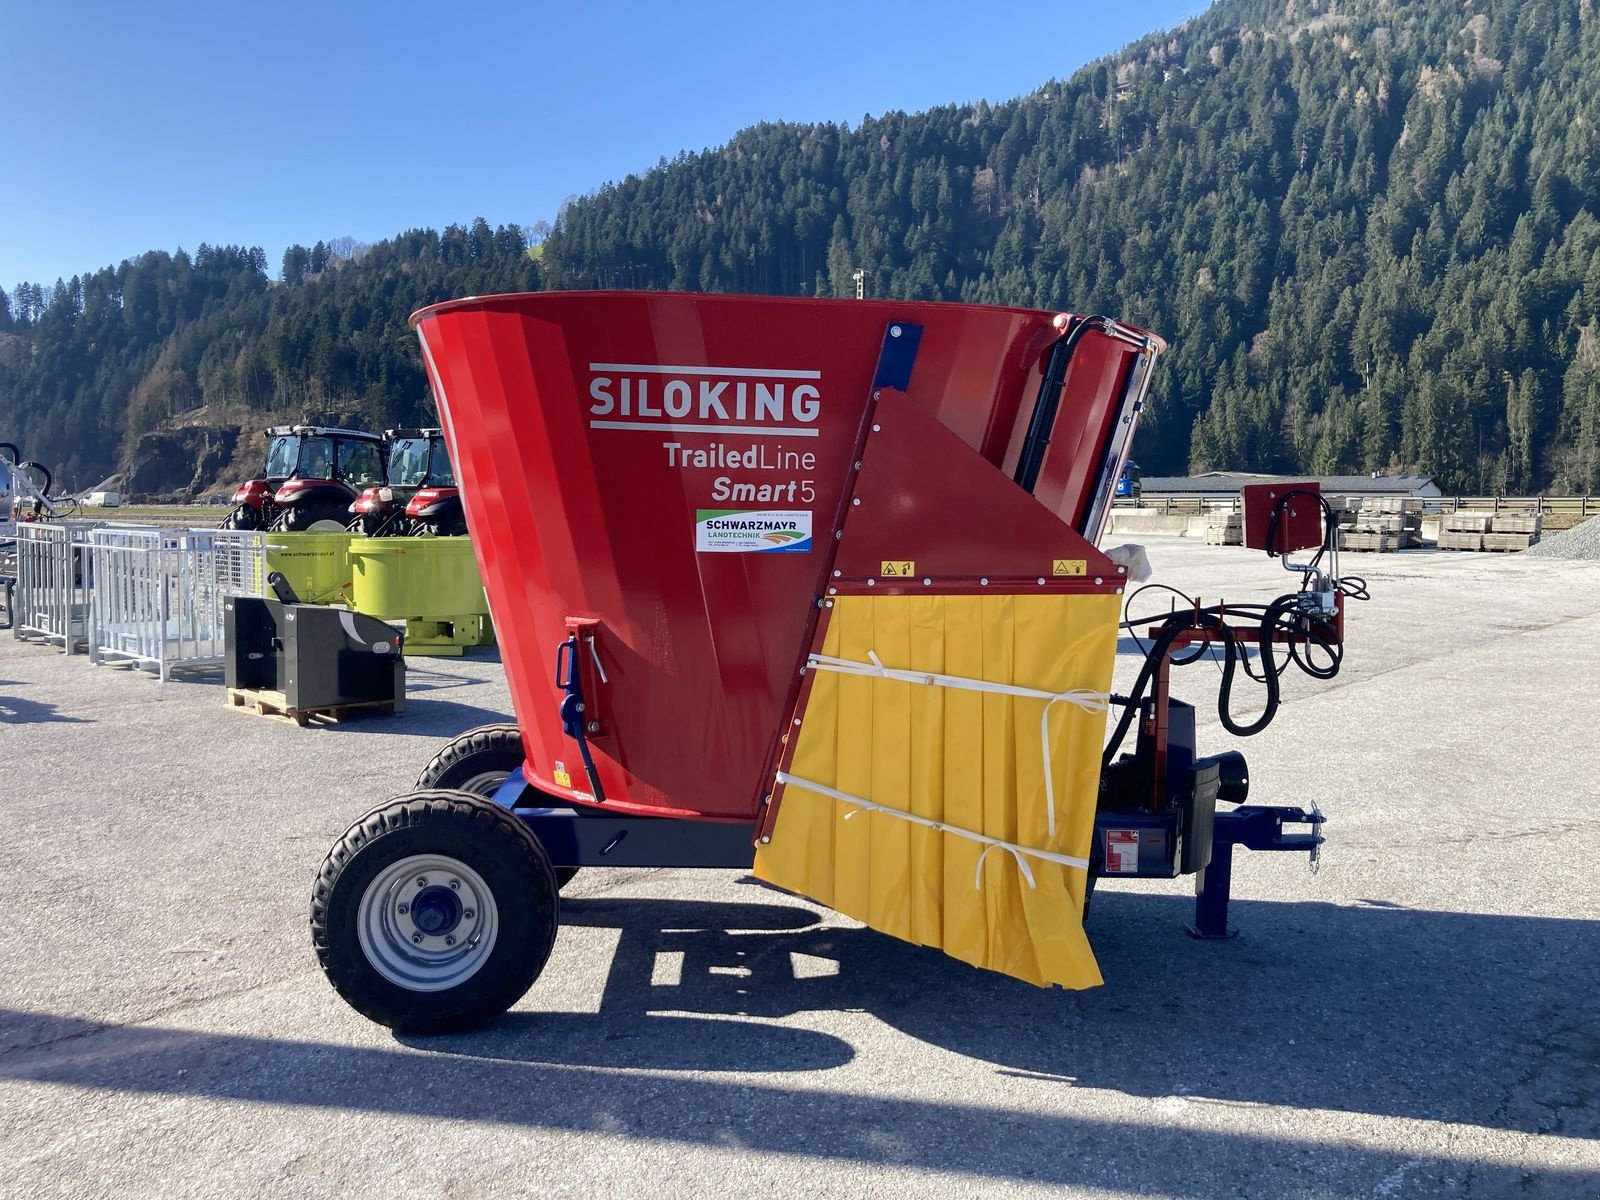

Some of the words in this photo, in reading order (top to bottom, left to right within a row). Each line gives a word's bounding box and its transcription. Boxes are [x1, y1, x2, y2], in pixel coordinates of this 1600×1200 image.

[589, 376, 821, 423] SILOKING
[662, 441, 816, 470] TrailedLine
[711, 476, 797, 503] Smart
[800, 480, 815, 503] 5
[706, 520, 797, 530] SCHWARZMAYR
[708, 531, 761, 539] LANDTECHNIK
